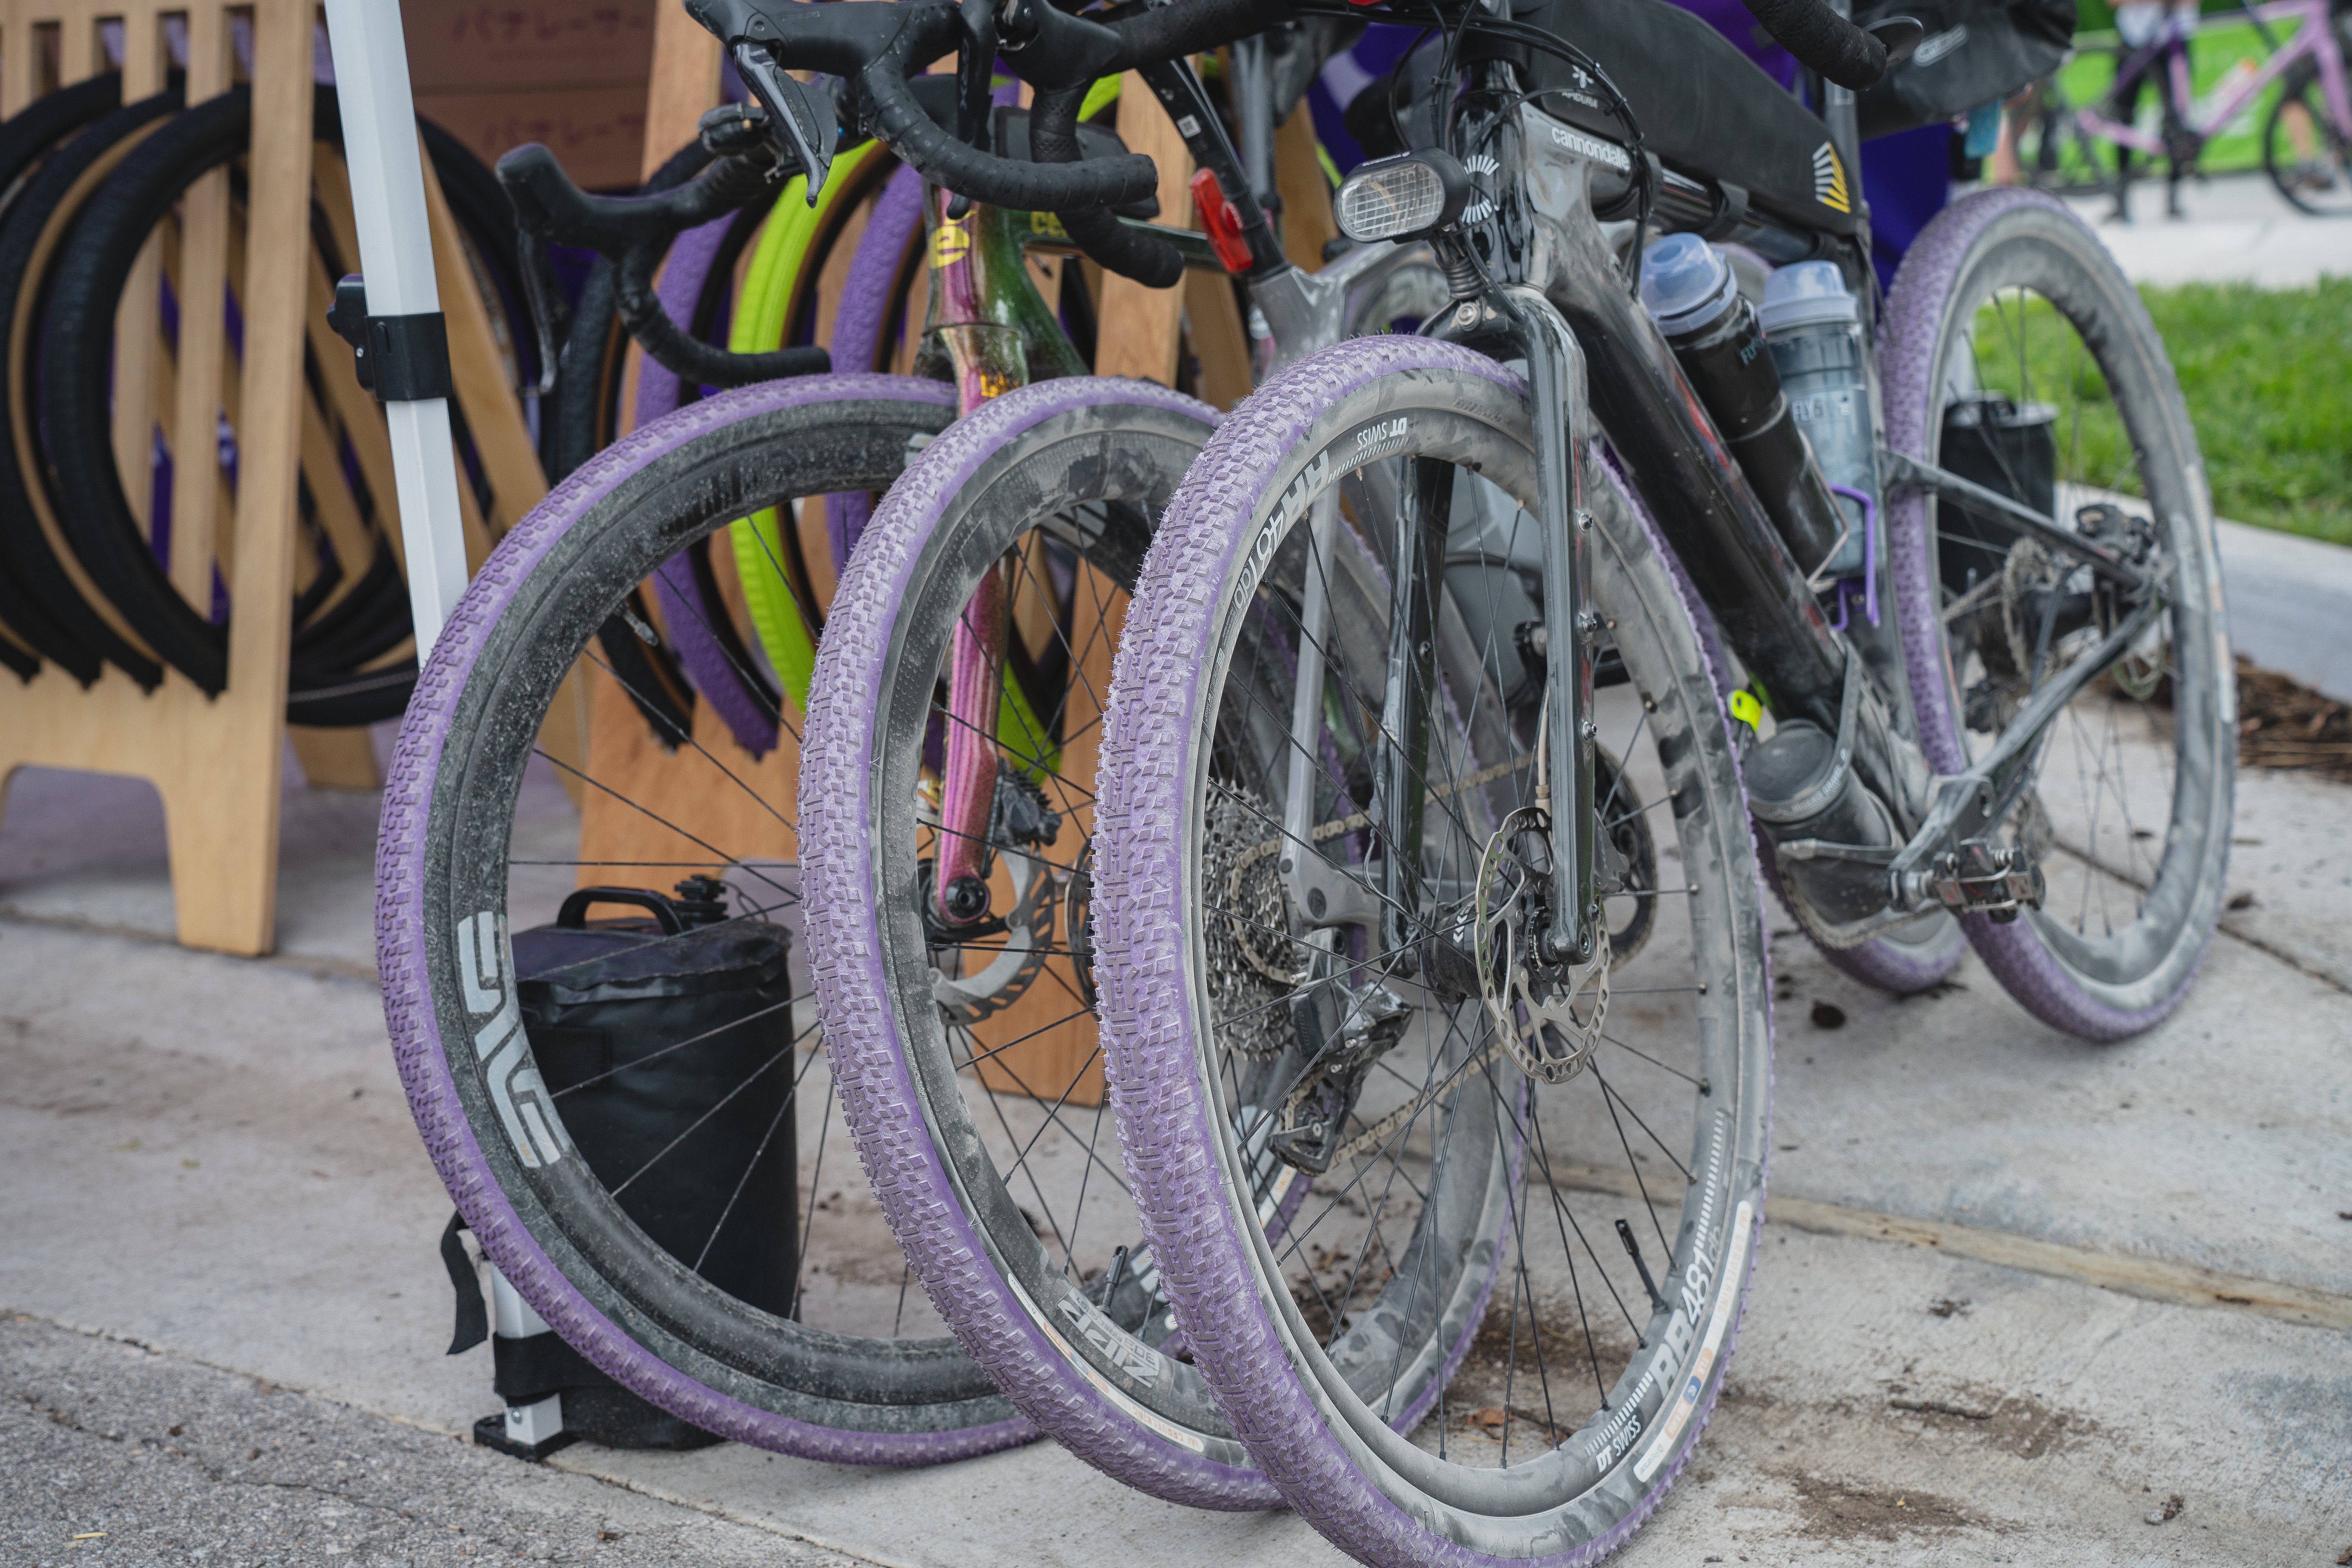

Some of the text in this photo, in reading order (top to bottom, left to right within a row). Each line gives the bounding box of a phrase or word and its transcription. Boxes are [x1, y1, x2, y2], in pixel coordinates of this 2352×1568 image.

[1552, 127, 1631, 172] cannondale
[1357, 417, 1407, 451] DT SWISS
[1281, 451, 1329, 520] RR
[1248, 510, 1284, 586] 481
[1207, 693, 1210, 702] DT
[458, 911, 572, 1167] ENVE
[1058, 1298, 1159, 1388] ZIPP
[1076, 1297, 1158, 1366] 303 FIRECREST
[1648, 1308, 1694, 1399] RR
[1681, 1247, 1715, 1325] 481
[1595, 1414, 1642, 1473] DT SWISS
